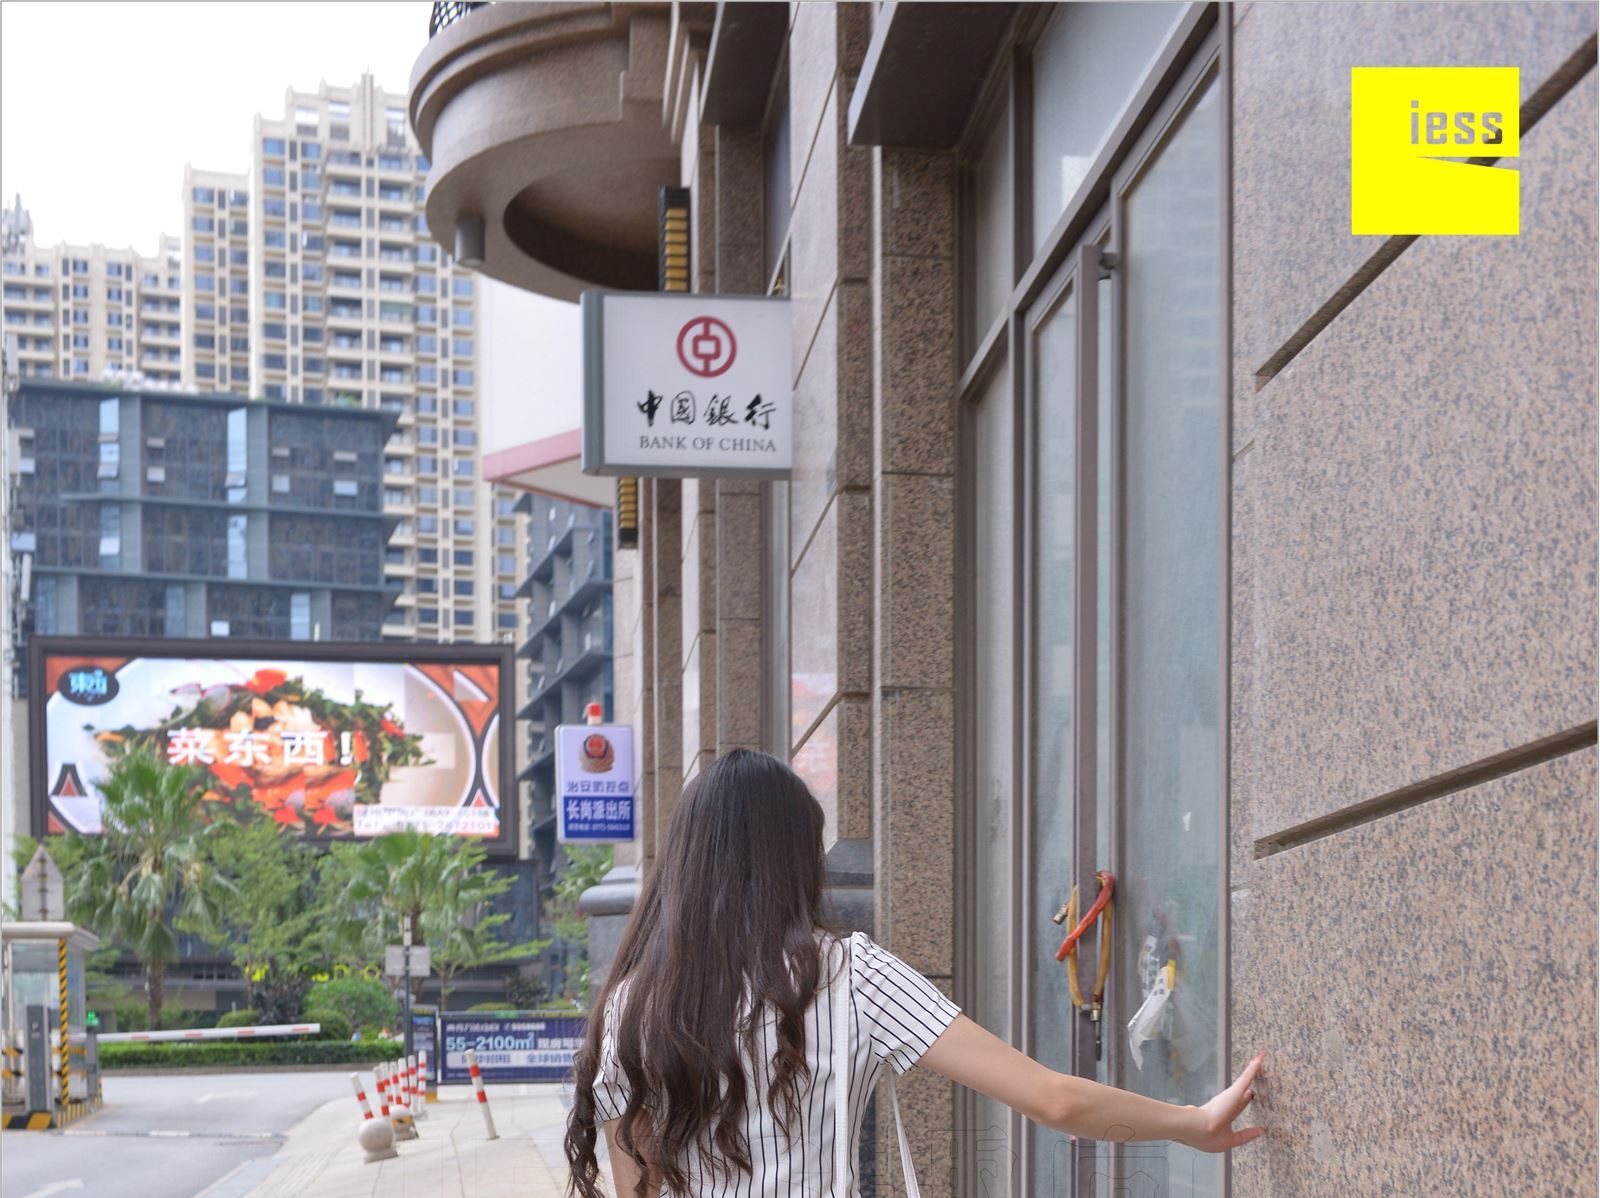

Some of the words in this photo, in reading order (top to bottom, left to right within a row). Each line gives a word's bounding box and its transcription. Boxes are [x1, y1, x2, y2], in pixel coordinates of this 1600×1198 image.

[640, 436, 687, 449] BANK
[692, 437, 714, 450] OF
[719, 438, 777, 452] CHINA
[567, 799, 631, 821] 长岗派出所
